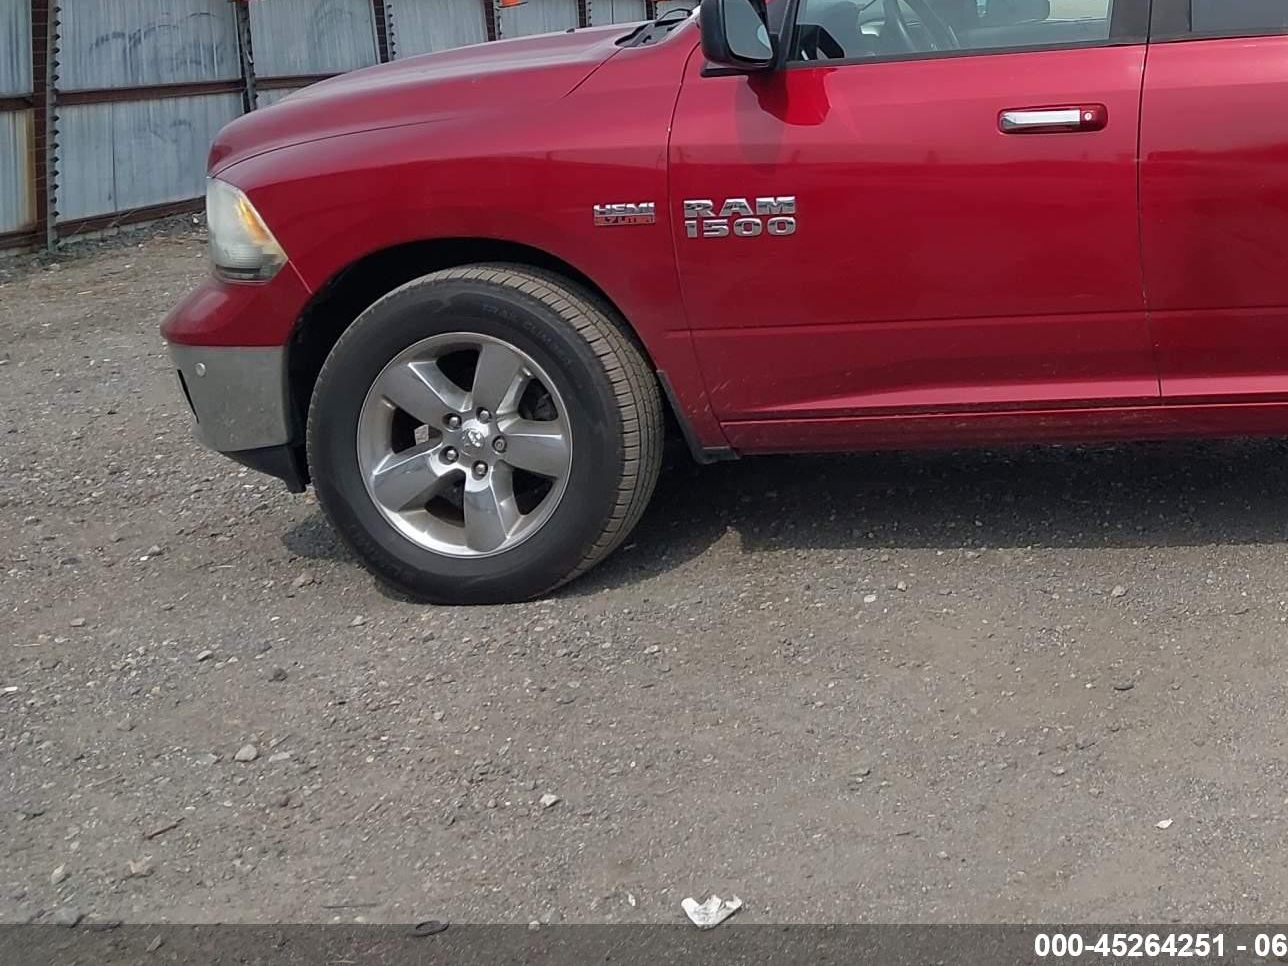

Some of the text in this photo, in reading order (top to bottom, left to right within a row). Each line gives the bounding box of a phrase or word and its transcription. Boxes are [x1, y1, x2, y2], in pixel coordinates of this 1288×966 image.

[593, 201, 656, 217] HEMI
[683, 195, 796, 218] RAM
[684, 217, 796, 238] 1500
